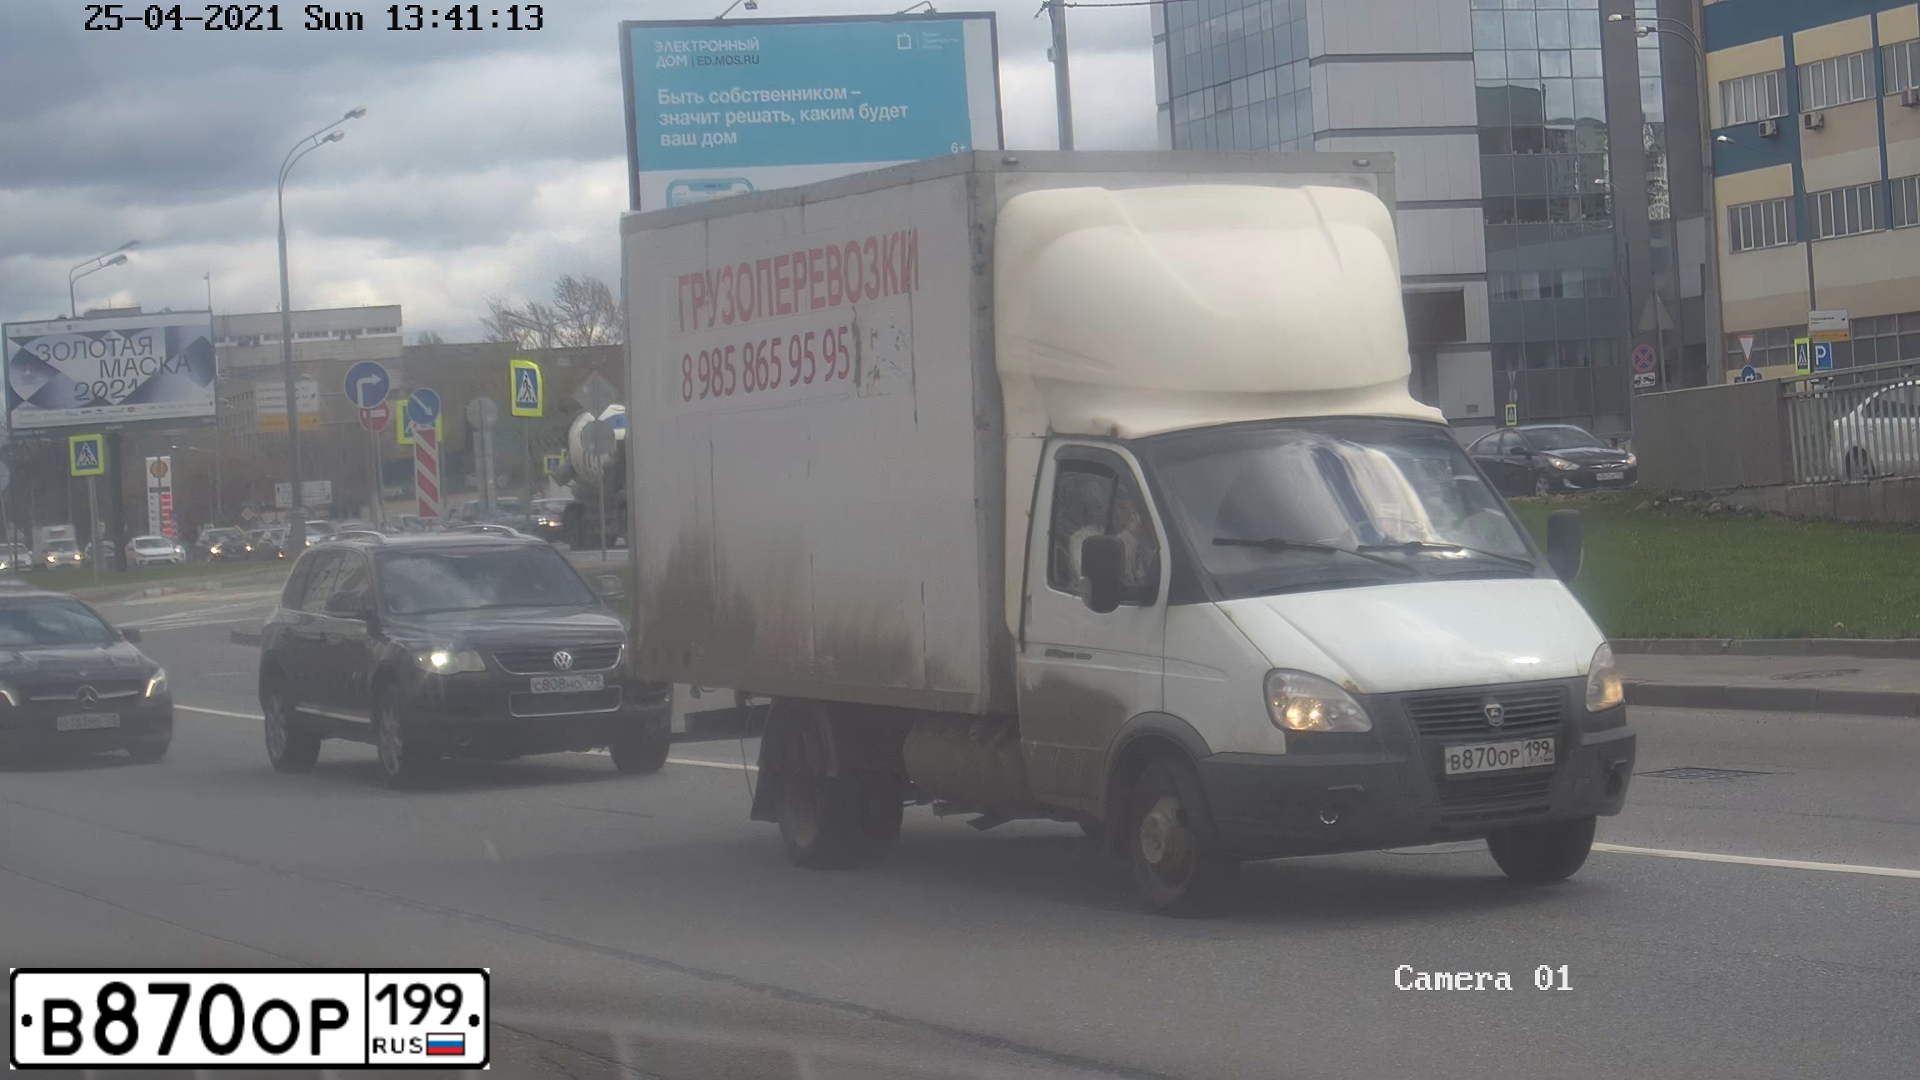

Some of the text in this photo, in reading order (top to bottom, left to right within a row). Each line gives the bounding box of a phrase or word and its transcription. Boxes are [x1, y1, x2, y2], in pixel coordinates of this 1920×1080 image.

[655, 36, 760, 54] ЭЛЕКТРОННЫЙ
[655, 54, 760, 70] ДОМ ED.MOS.RU
[657, 87, 704, 106] Быть
[708, 85, 847, 105] собственником
[658, 102, 909, 127] значит решать, каким будет
[660, 130, 737, 148] ваш дом
[950, 141, 967, 154] 6+
[677, 227, 920, 333] ГРУЗОПЕРЕВОЗКИ
[35, 336, 153, 363] ЗОЛОТАЯ
[100, 354, 192, 379] МАСКА
[682, 326, 850, 403] 8 985 865 95 95
[1450, 747, 1521, 771] В870ОР
[1524, 740, 1550, 757] 199
